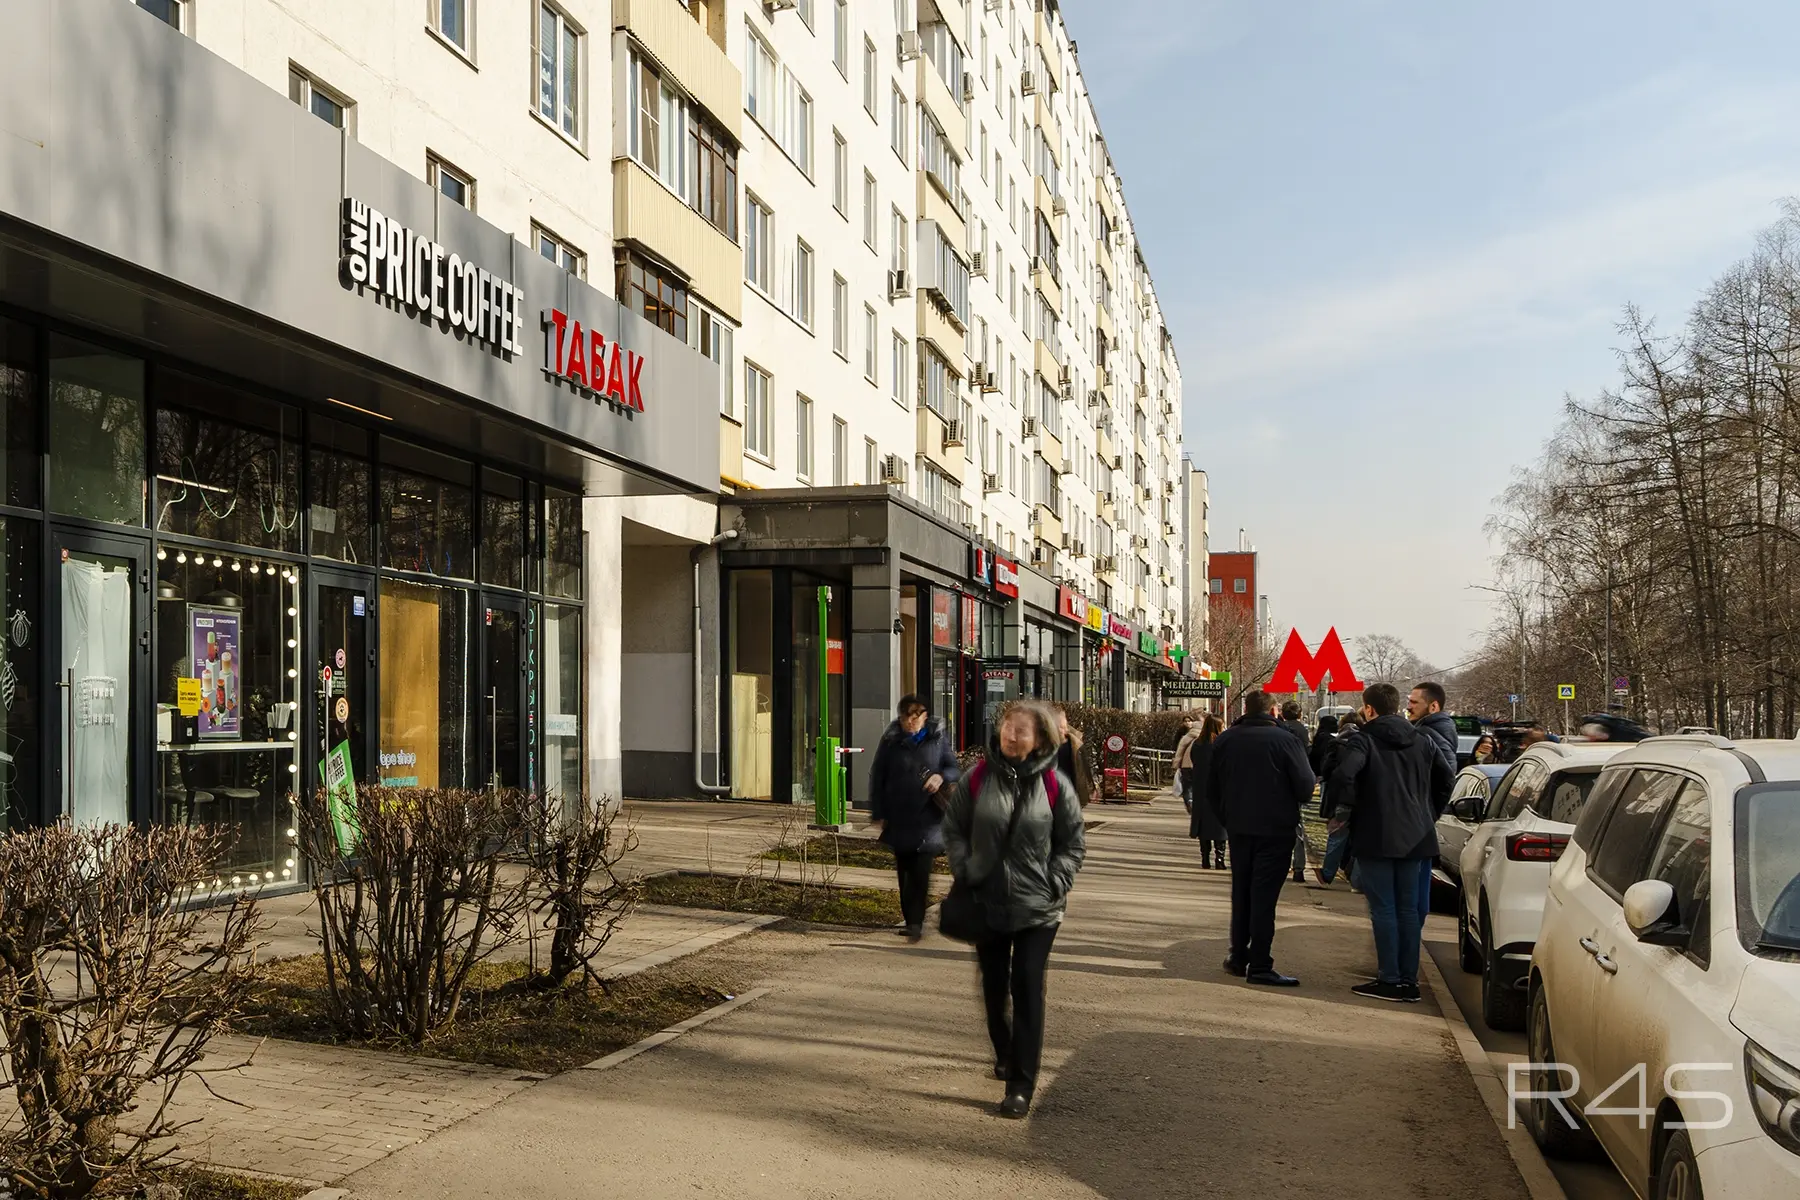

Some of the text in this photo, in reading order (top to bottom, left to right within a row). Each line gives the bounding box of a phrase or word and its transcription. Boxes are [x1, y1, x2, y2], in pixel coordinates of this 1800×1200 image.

[349, 197, 524, 356] ONE PRICE COFFEE
[551, 307, 645, 413] ТАБАК
[1163, 681, 1222, 690] МЕНДЕЛЕЕВ
